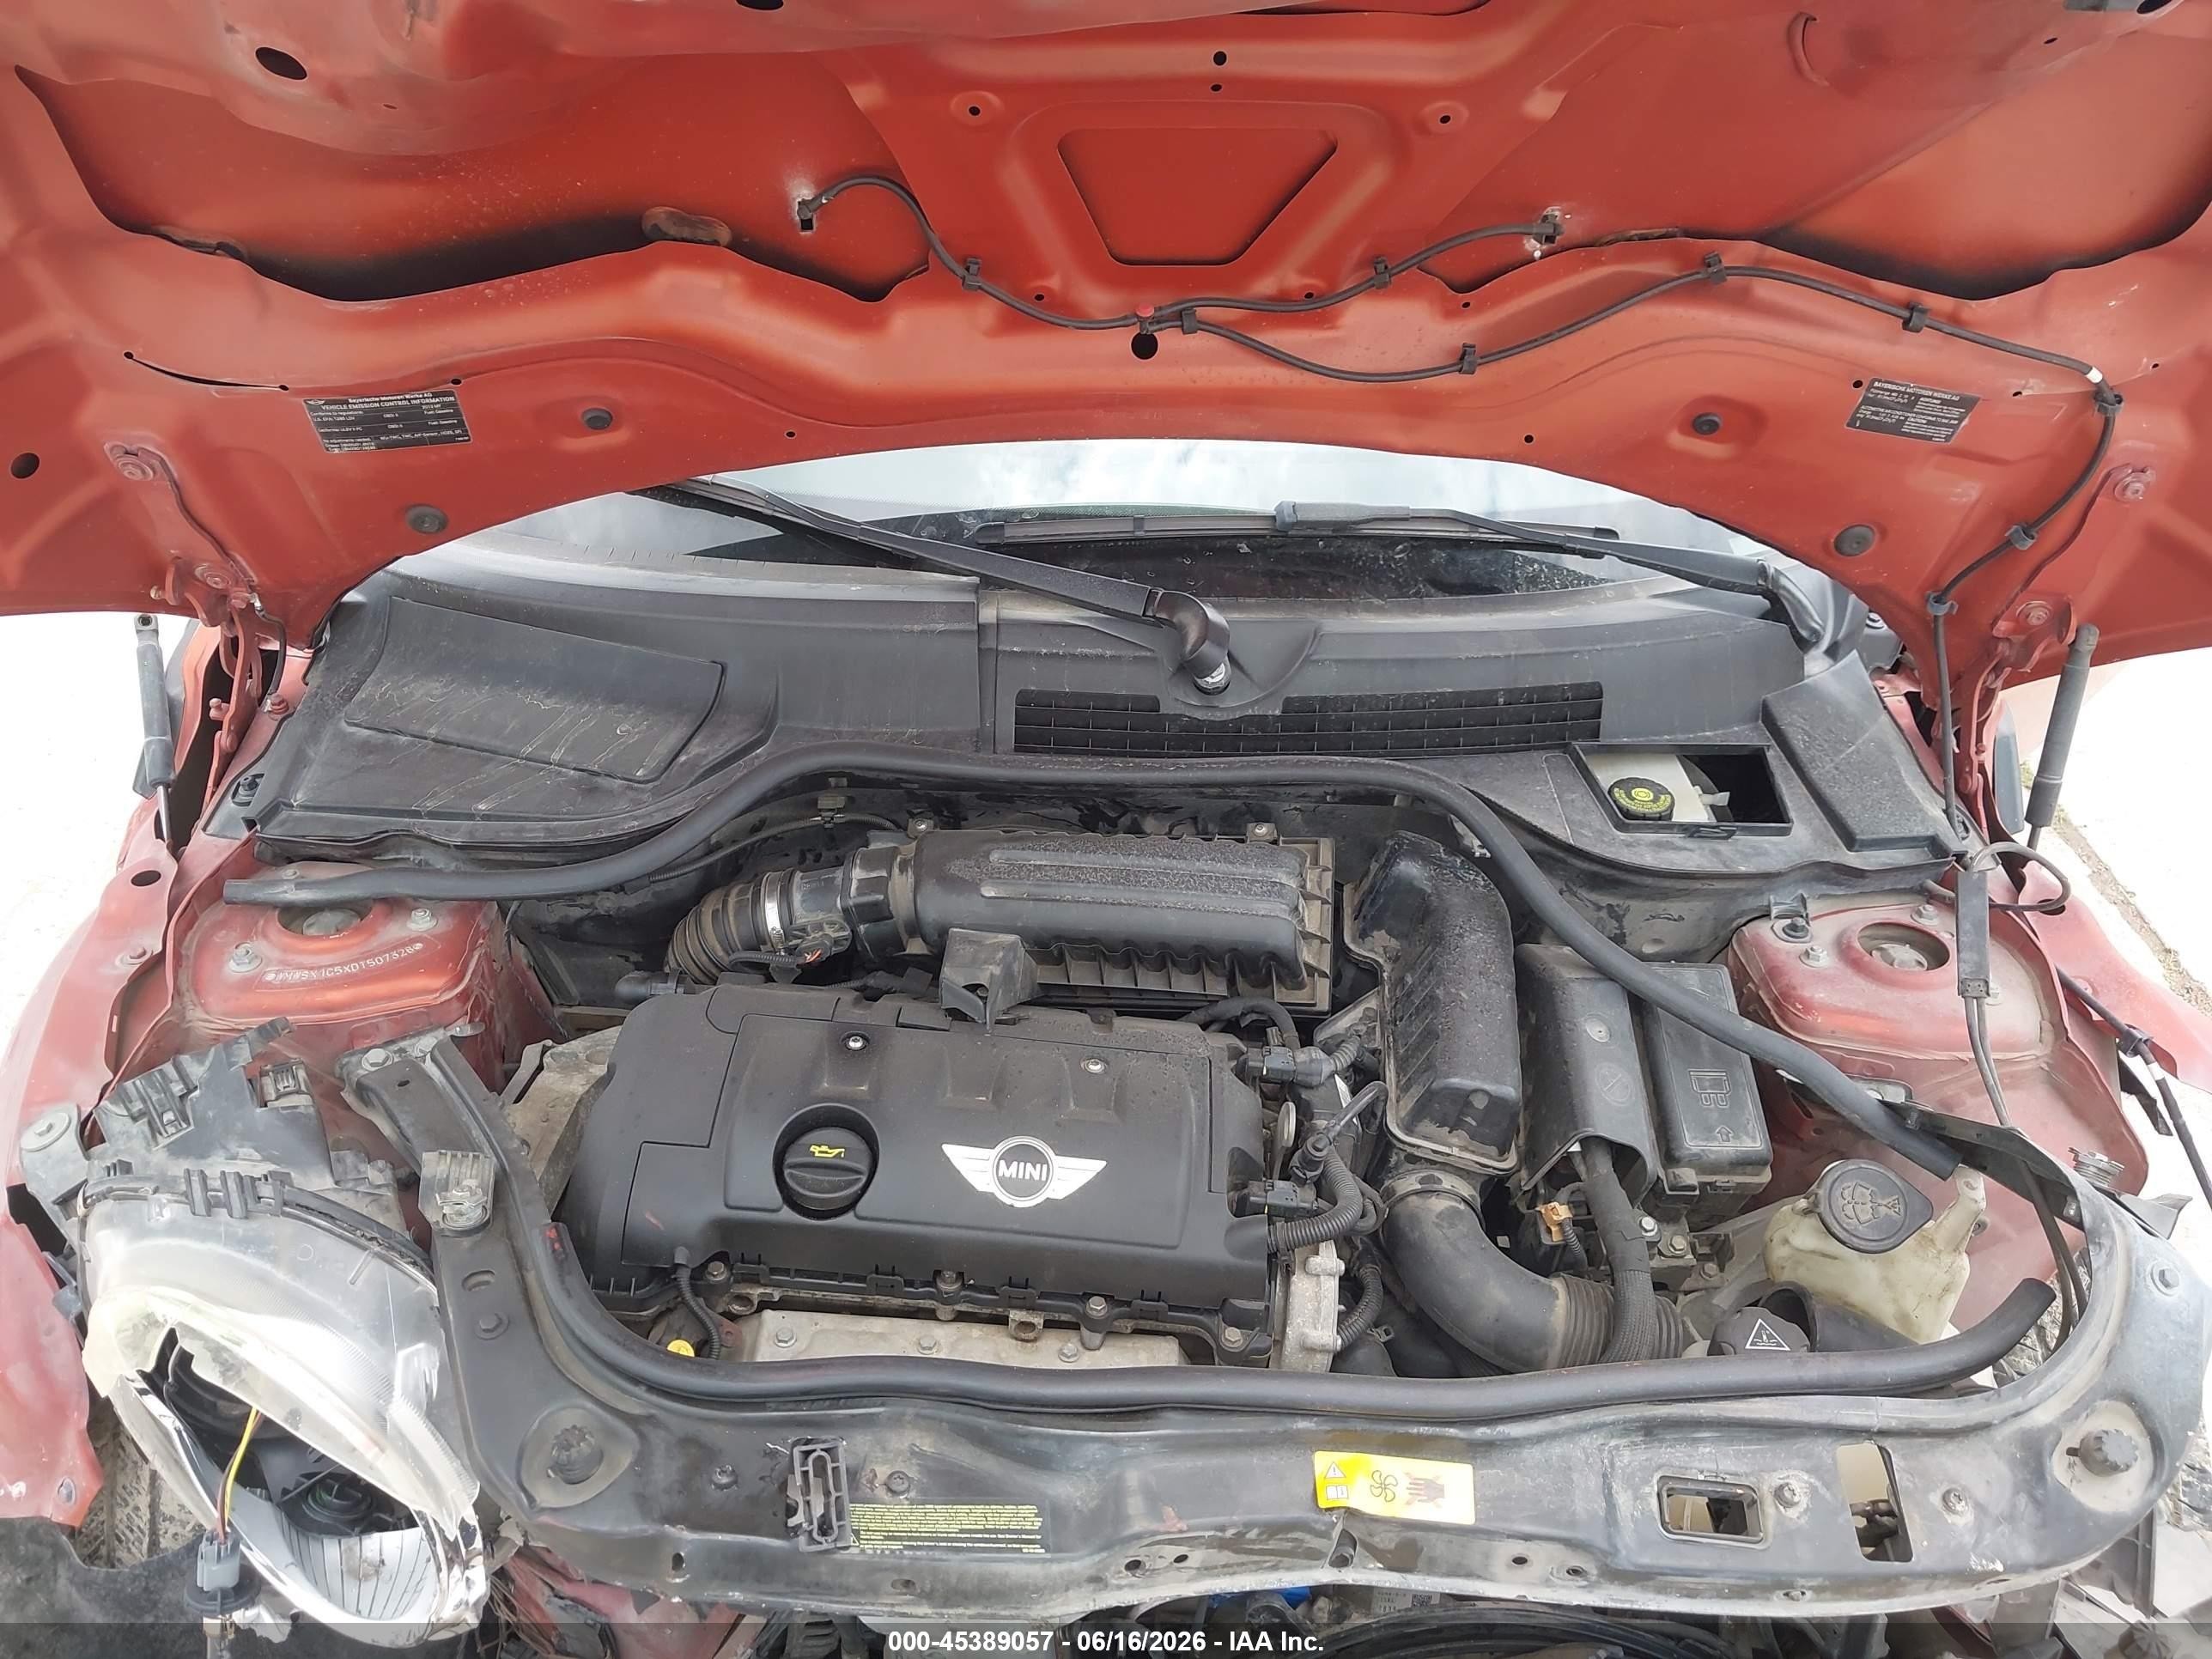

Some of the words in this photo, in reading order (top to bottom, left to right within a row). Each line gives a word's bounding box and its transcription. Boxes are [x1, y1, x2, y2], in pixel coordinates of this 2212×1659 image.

[380, 399, 410, 408] CONTROL
[410, 396, 455, 406] INFORMATION
[998, 1159, 1048, 1182] MINI
